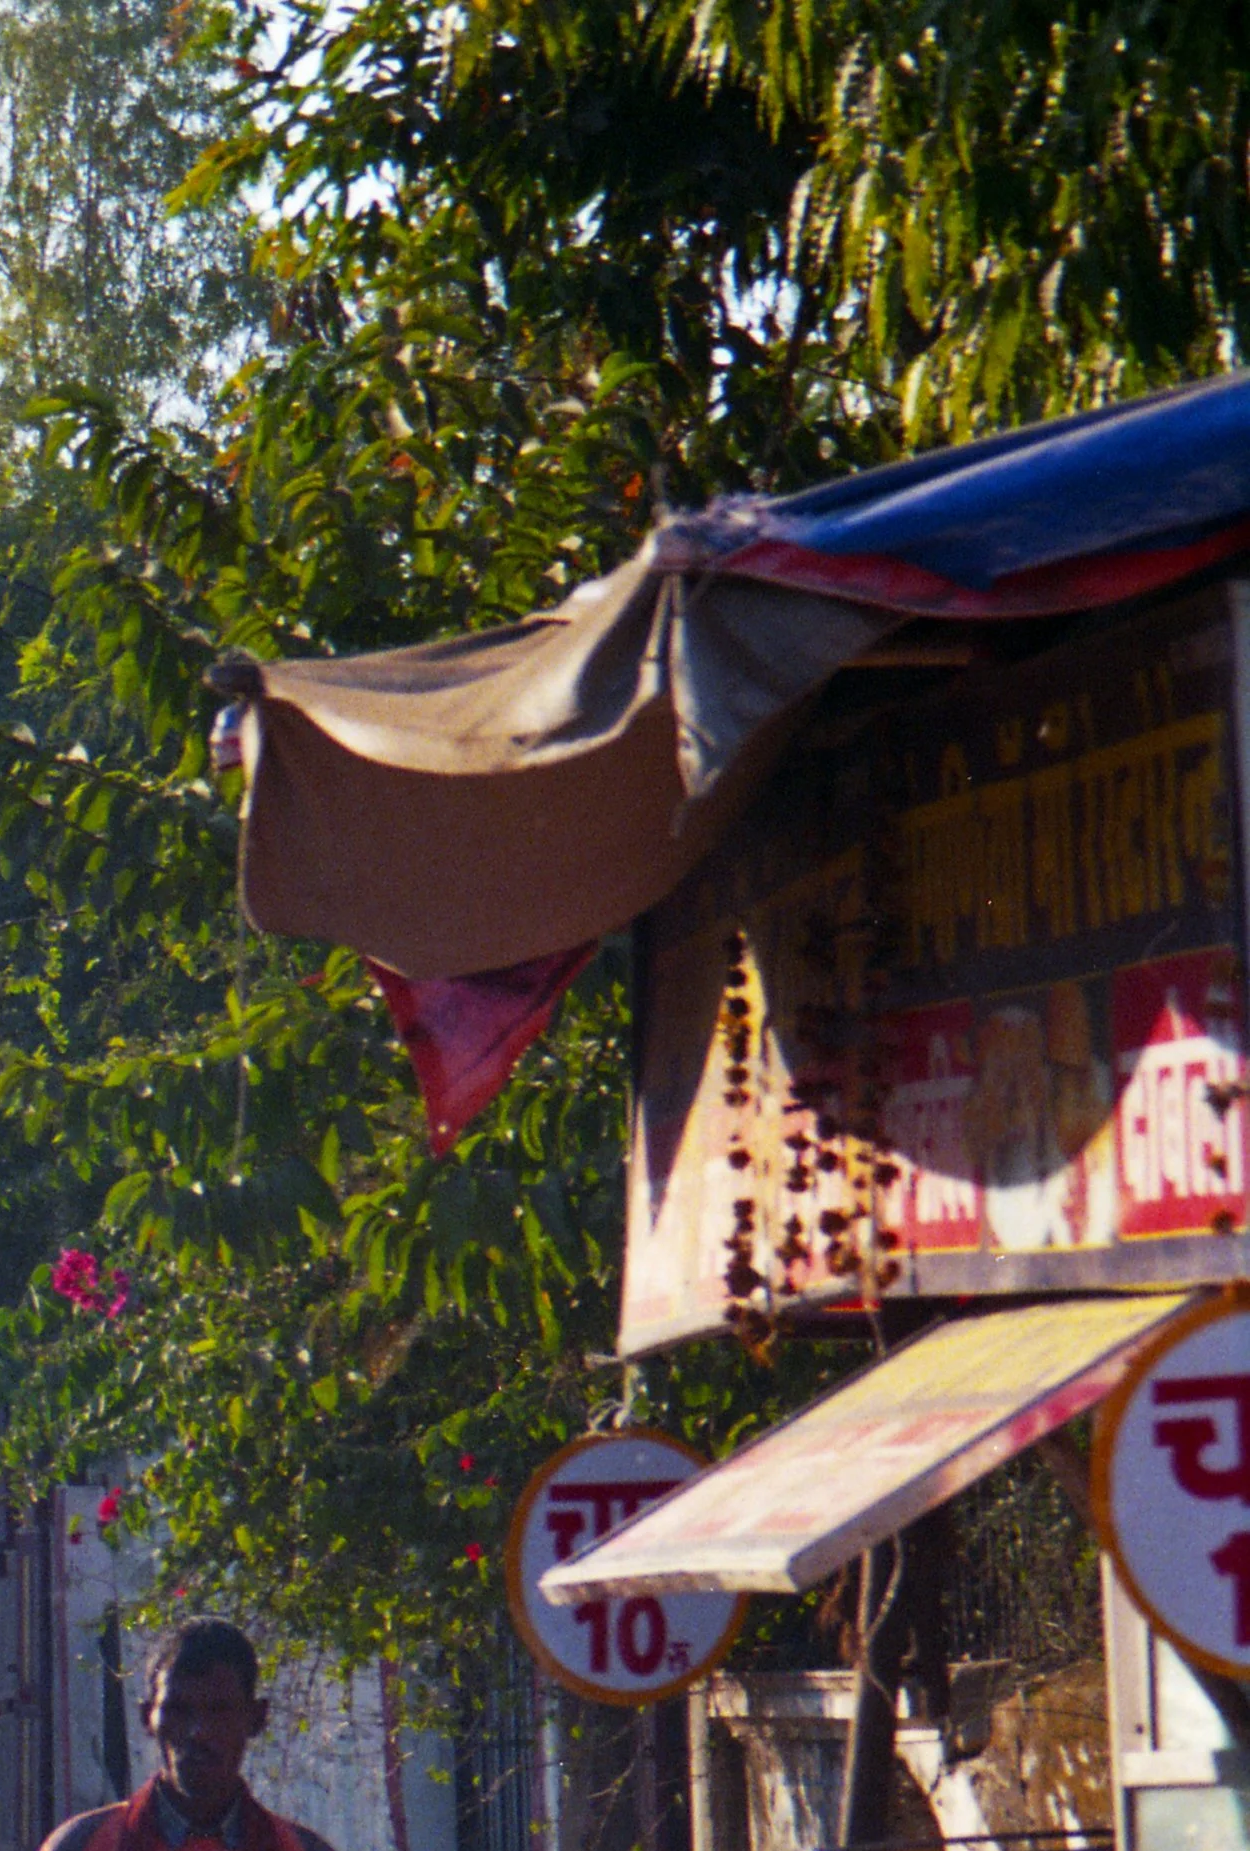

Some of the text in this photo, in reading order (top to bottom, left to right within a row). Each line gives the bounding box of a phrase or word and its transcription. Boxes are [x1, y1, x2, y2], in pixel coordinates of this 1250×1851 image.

[1152, 1374, 1250, 1507] च
[546, 1480, 684, 1562] चा
[573, 1594, 667, 1678] 10
